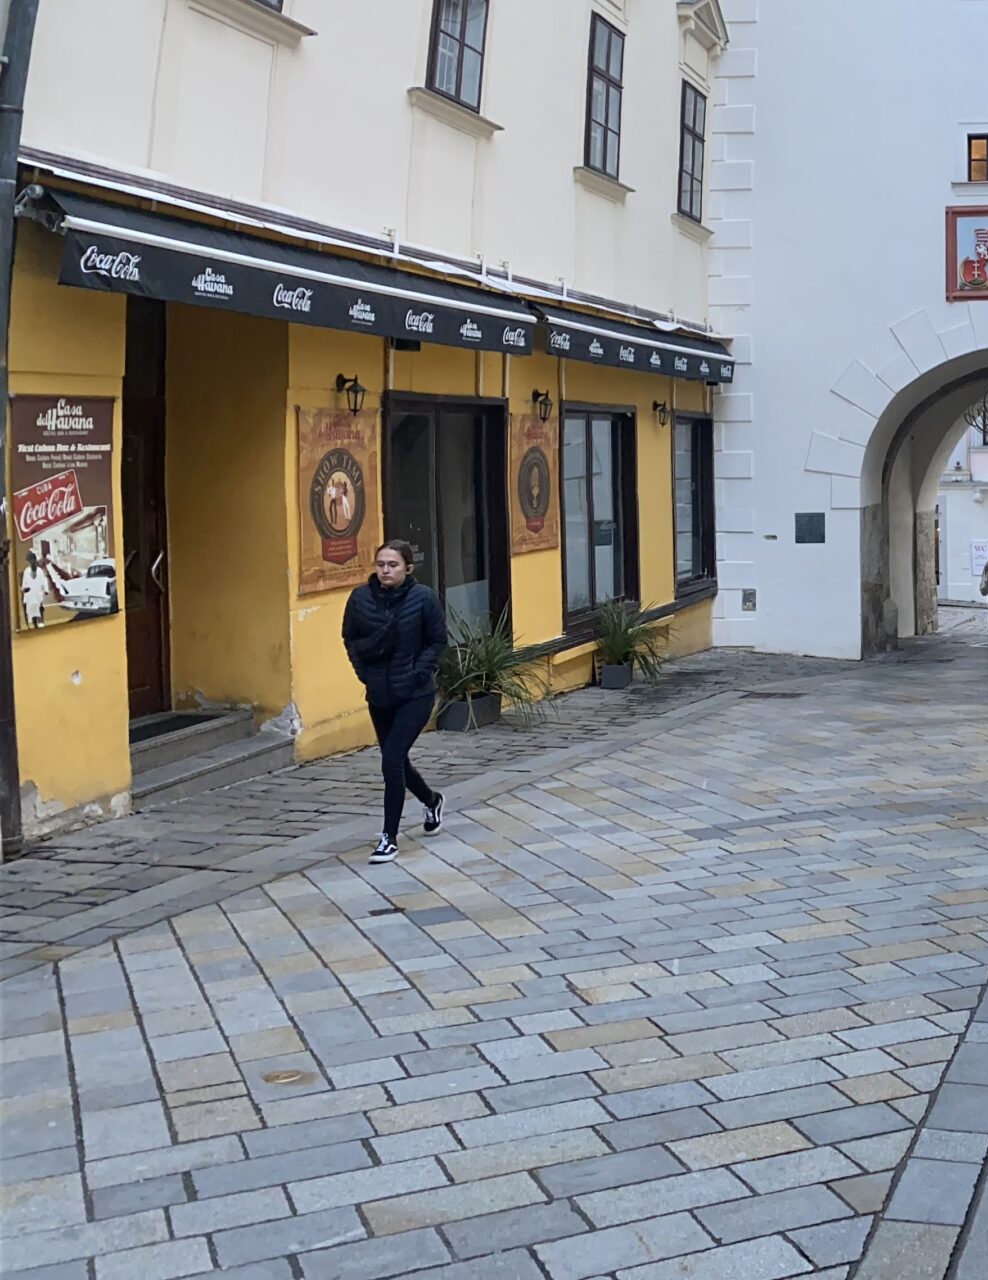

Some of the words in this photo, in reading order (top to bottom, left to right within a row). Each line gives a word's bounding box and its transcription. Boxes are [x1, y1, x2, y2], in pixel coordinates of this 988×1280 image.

[205, 267, 225, 283] Casa
[57, 399, 83, 417] Casa
[47, 408, 94, 431] Havana
[20, 483, 76, 533] Coca-Cola
